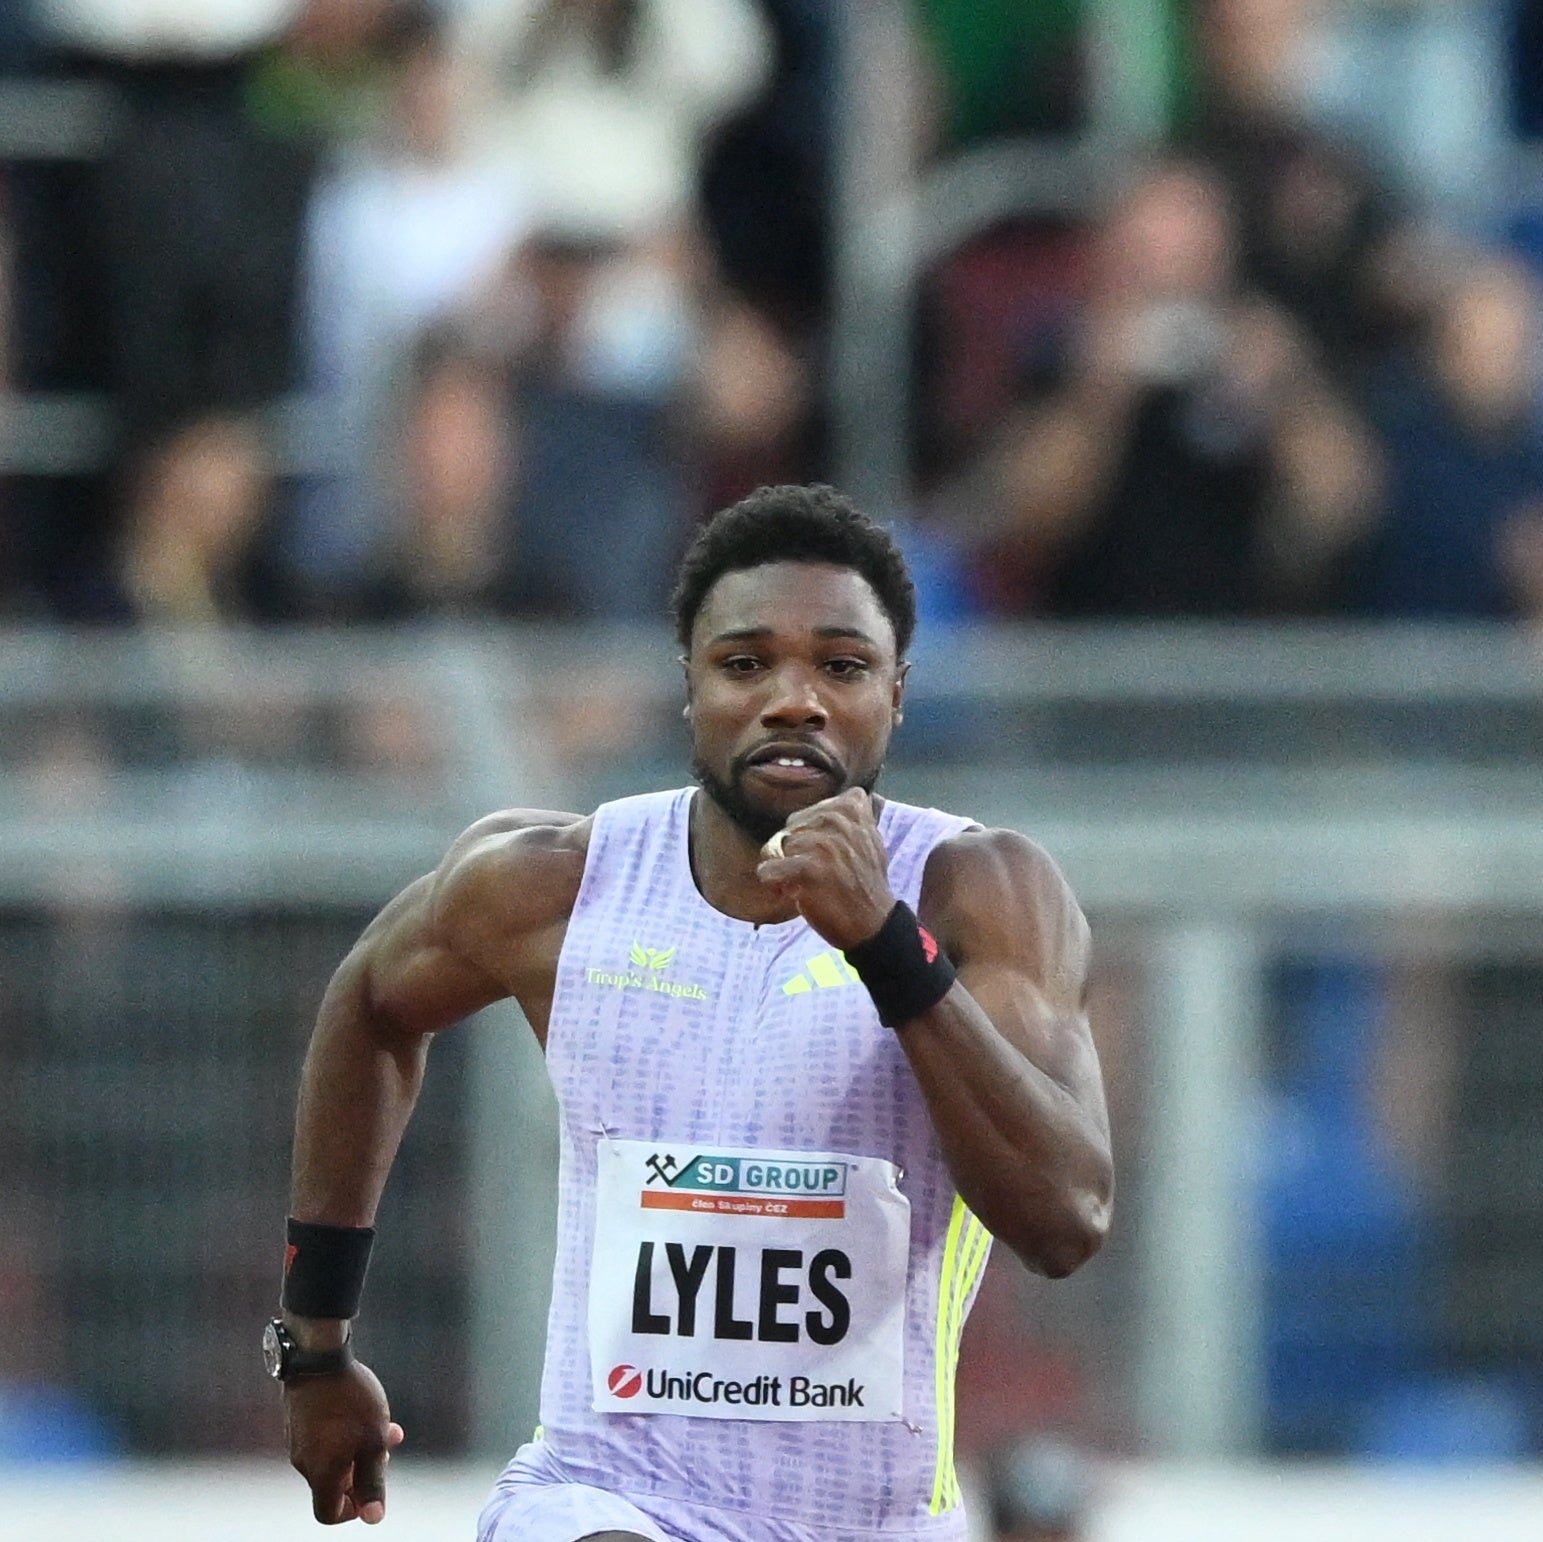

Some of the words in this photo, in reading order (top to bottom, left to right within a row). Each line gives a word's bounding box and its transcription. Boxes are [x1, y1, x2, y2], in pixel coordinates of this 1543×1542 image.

[587, 967, 642, 990] Tirop's
[646, 975, 708, 1000] Angels
[697, 1163, 734, 1185] SD
[746, 1165, 839, 1191] GROUP
[632, 1241, 852, 1345] LYLES
[646, 1369, 782, 1406] UniCredit
[790, 1376, 865, 1407] Bank
